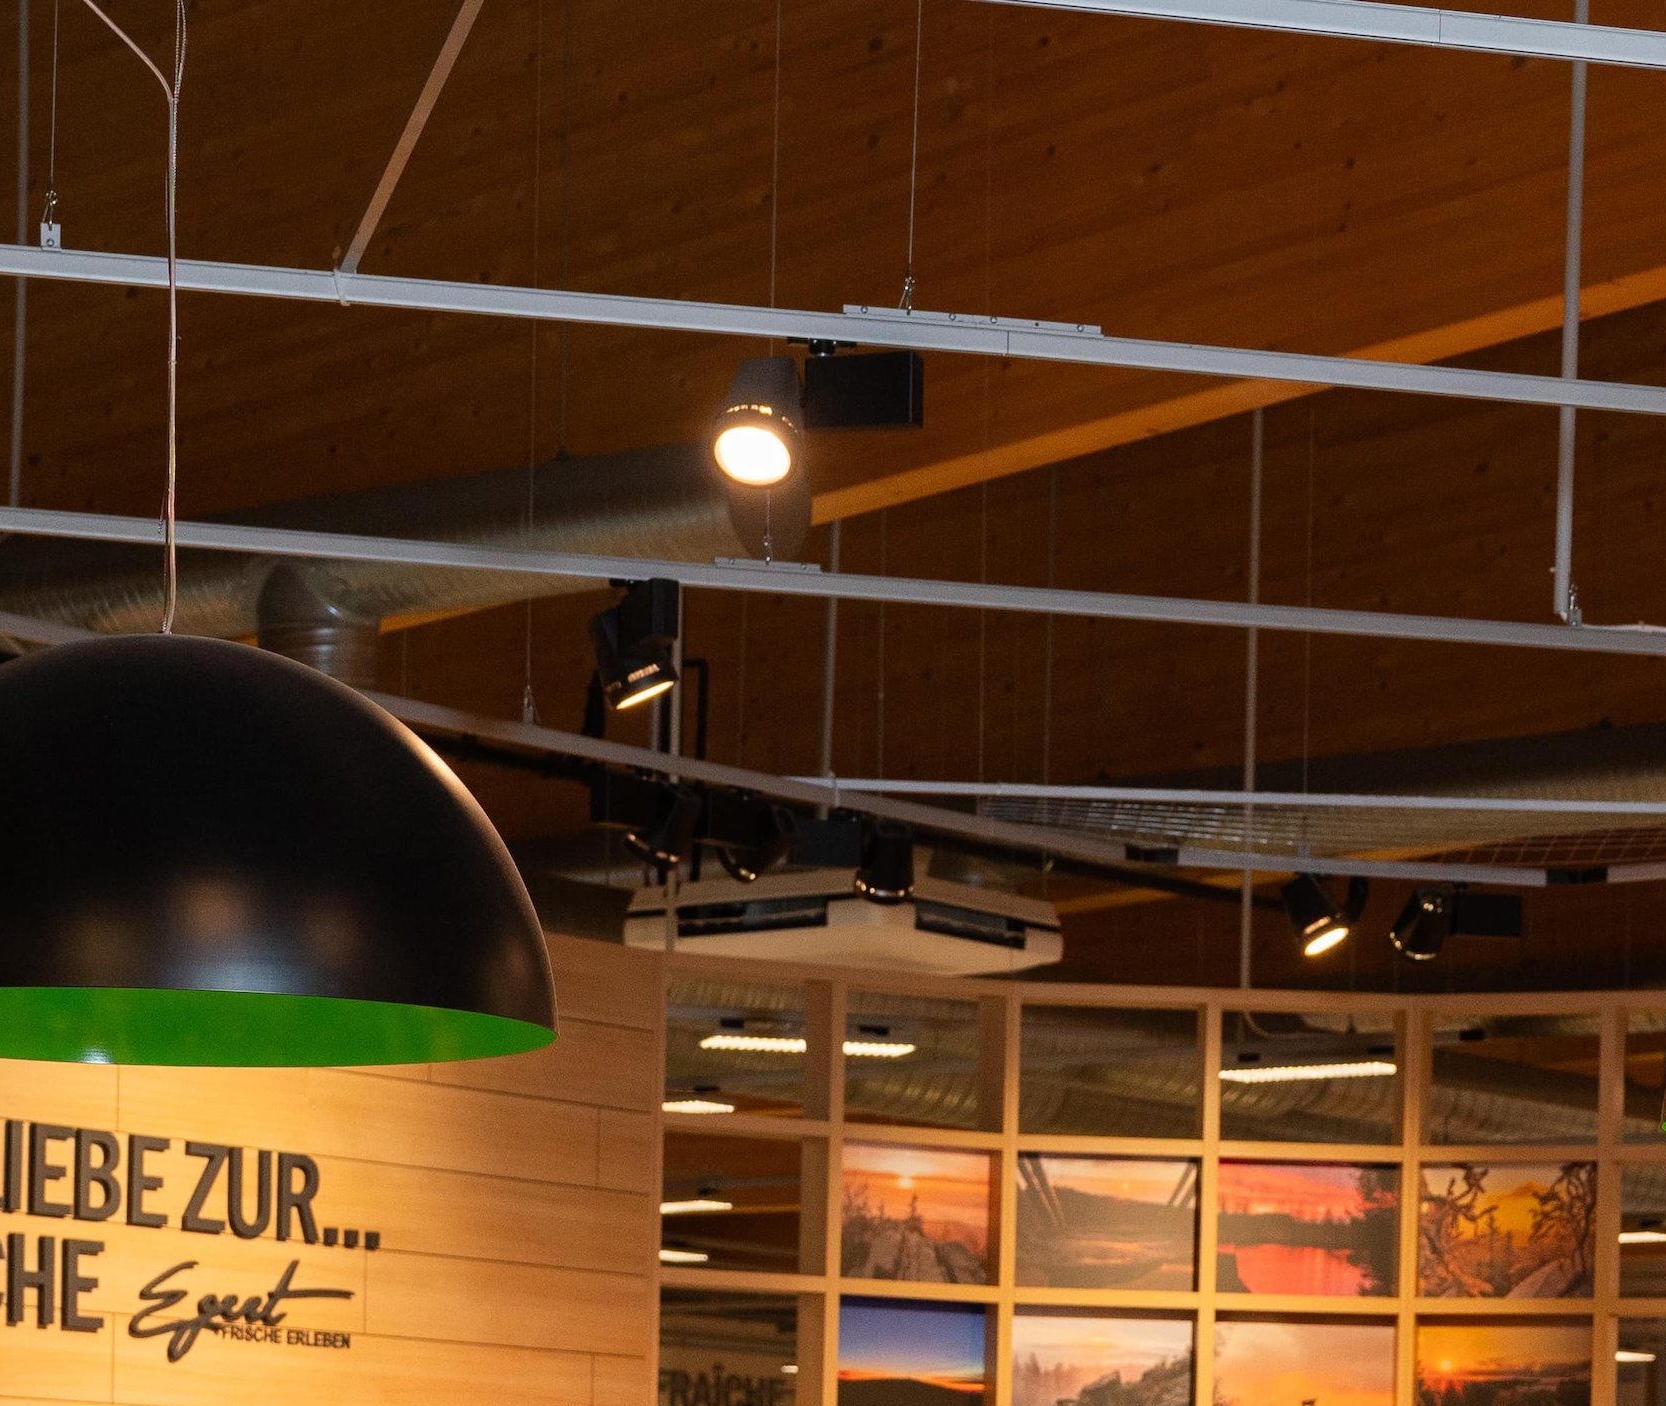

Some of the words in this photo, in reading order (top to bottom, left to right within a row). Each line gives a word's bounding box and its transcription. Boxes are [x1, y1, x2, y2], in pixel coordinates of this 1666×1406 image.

[181, 1140, 380, 1251] ZUR...
[220, 1326, 282, 1345] FRISCHE
[287, 1328, 351, 1349] ERLEBEN
